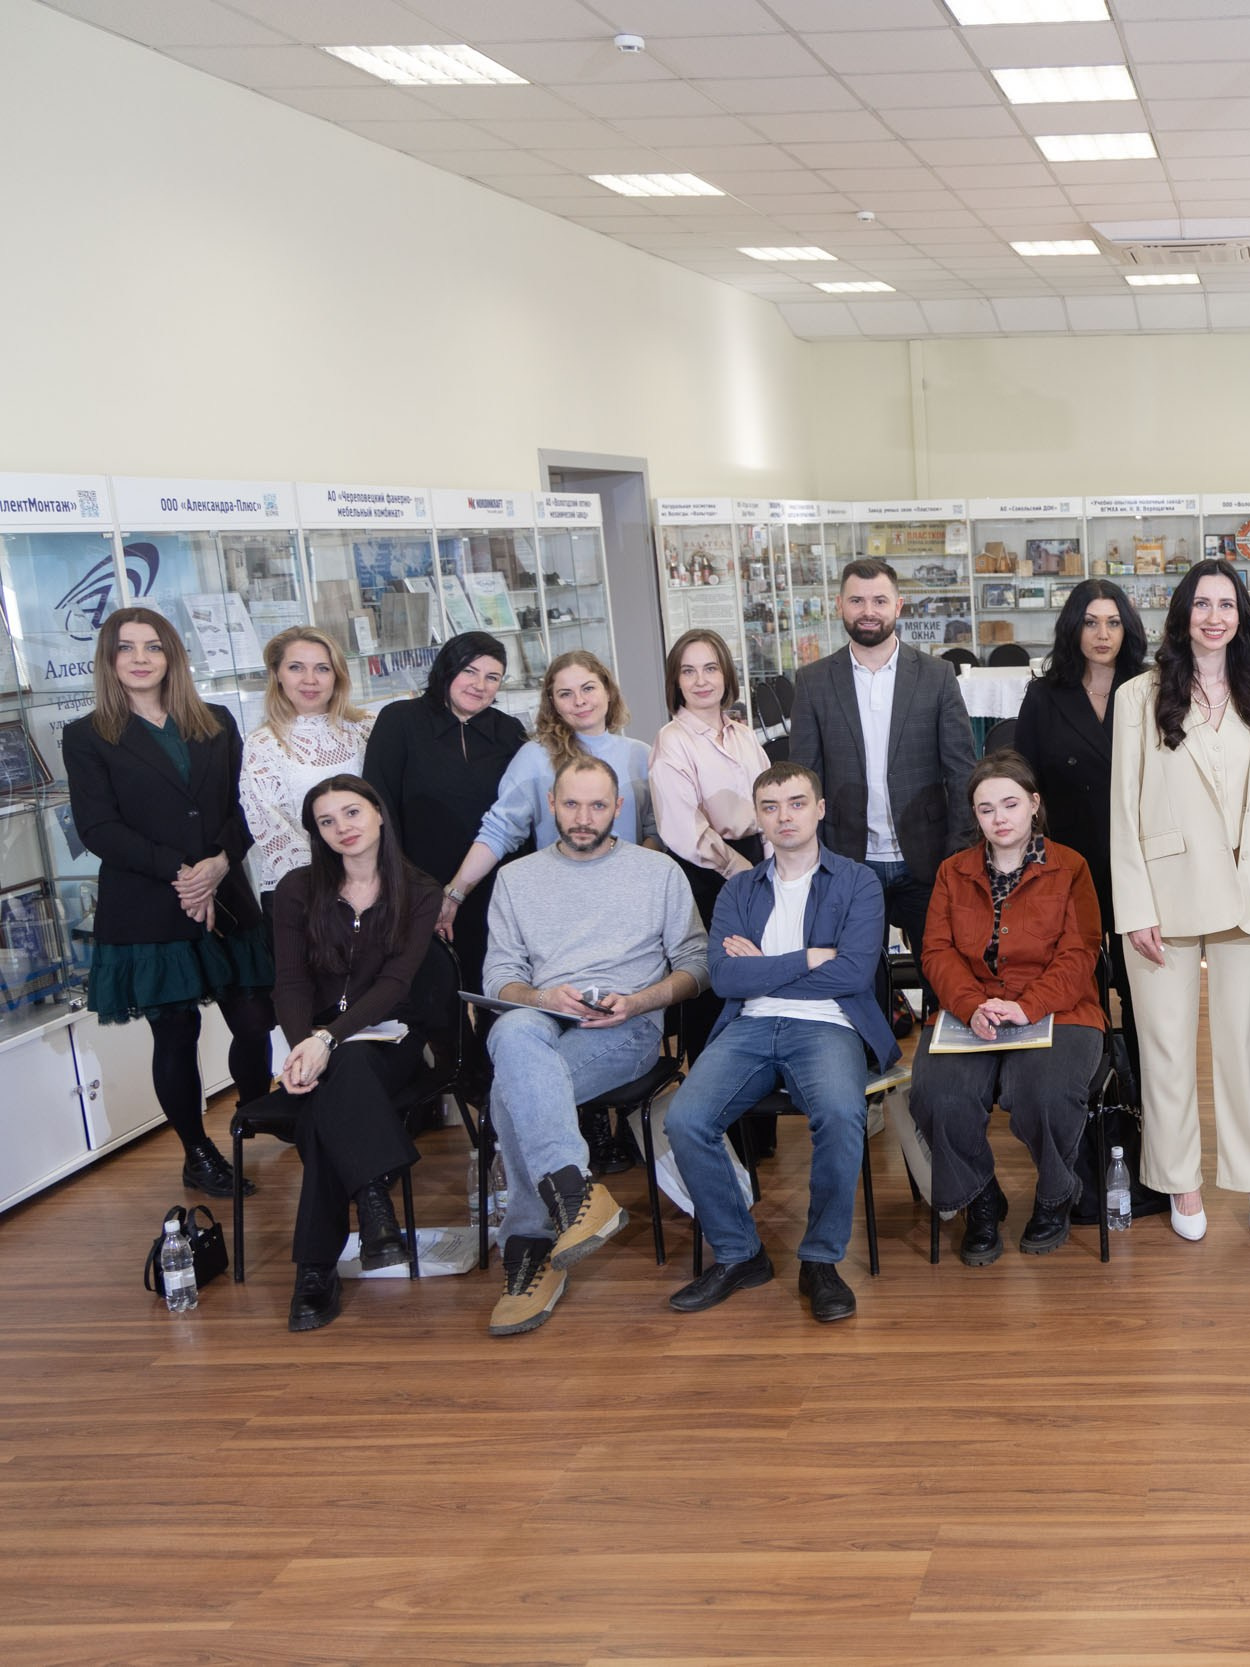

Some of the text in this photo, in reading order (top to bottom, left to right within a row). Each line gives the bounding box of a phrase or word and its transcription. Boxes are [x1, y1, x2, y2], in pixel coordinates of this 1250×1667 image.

[327, 490, 337, 502] АО
[160, 498, 262, 513] ООО «Александра-Плюс»
[904, 621, 941, 631] МЯГКИЕ
[911, 631, 936, 640] ОКНА
